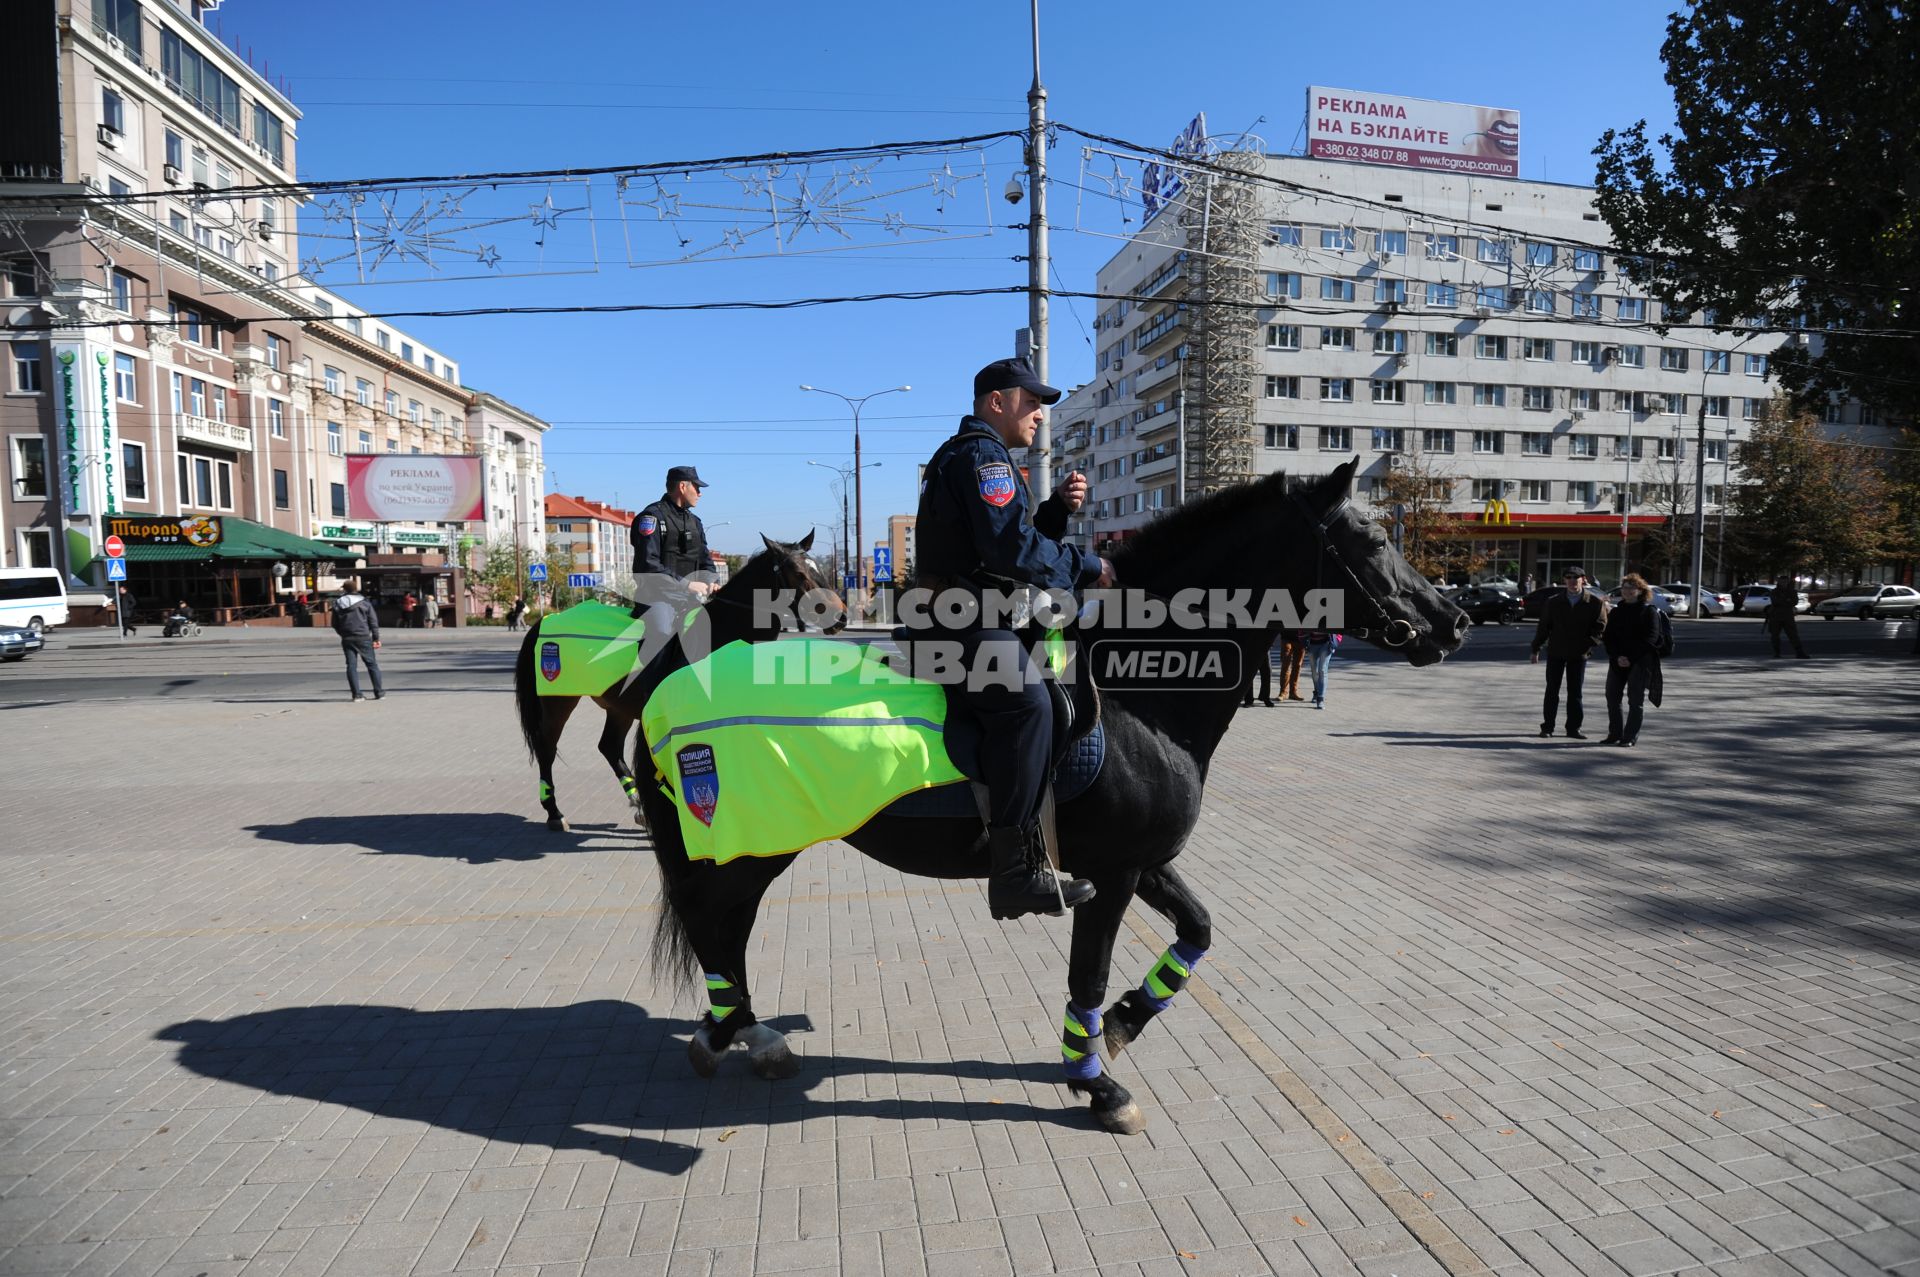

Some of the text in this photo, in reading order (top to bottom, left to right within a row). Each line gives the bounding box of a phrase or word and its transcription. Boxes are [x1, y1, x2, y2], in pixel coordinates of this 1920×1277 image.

[1318, 96, 1407, 120] РЕКЛАМА
[1318, 118, 1449, 145] НА БЭКЛАЙТЕ
[1317, 143, 1512, 173] +380 62 348 07 88 www.fcgroup.com.ua
[390, 469, 440, 478] РЕКЛАМА
[415, 482, 453, 493] Украине
[680, 748, 711, 762] ПОЛИЦИЯ
